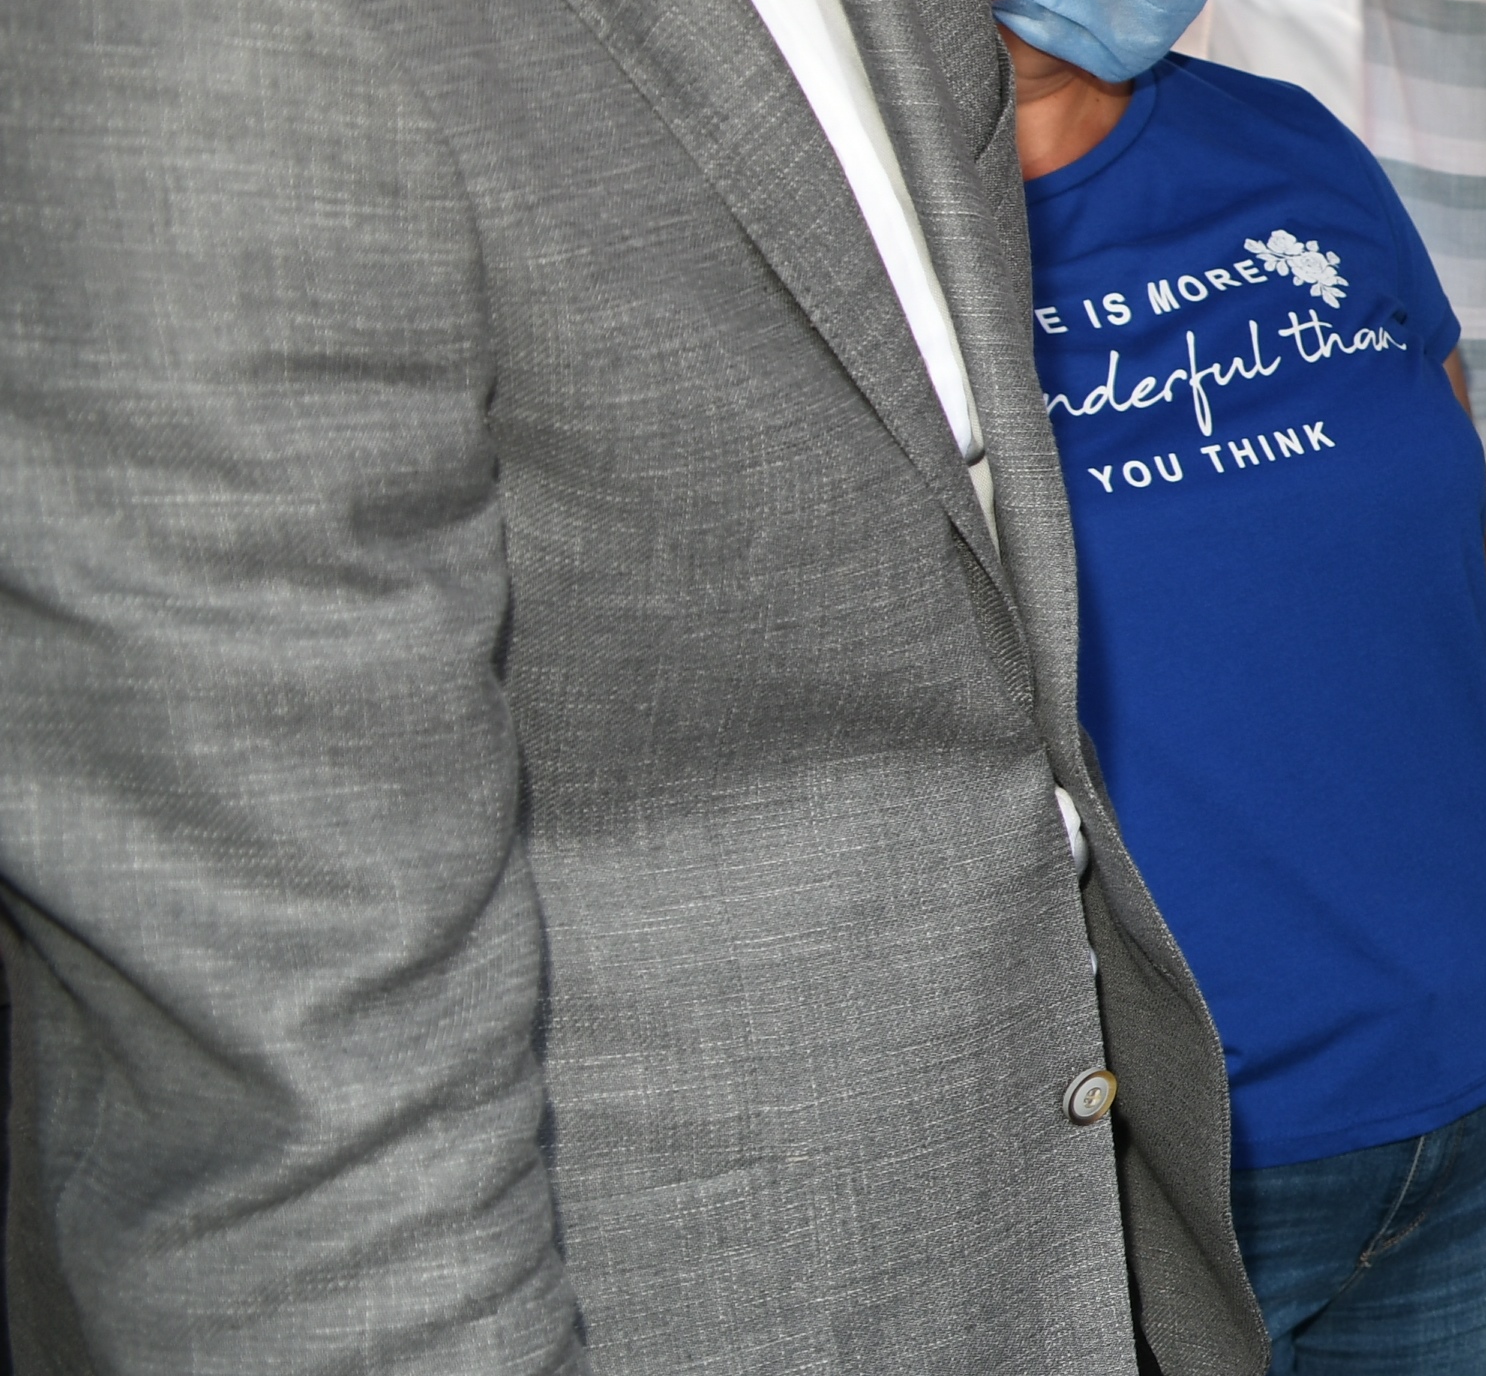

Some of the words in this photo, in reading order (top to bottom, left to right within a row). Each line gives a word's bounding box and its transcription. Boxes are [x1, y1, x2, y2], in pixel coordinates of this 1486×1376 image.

[1082, 292, 1133, 329] IS
[1147, 259, 1267, 316] MORE
[1043, 319, 1282, 437] nderful
[1278, 308, 1407, 364] than
[1088, 453, 1183, 494] YOU
[1200, 421, 1336, 474] THINK
